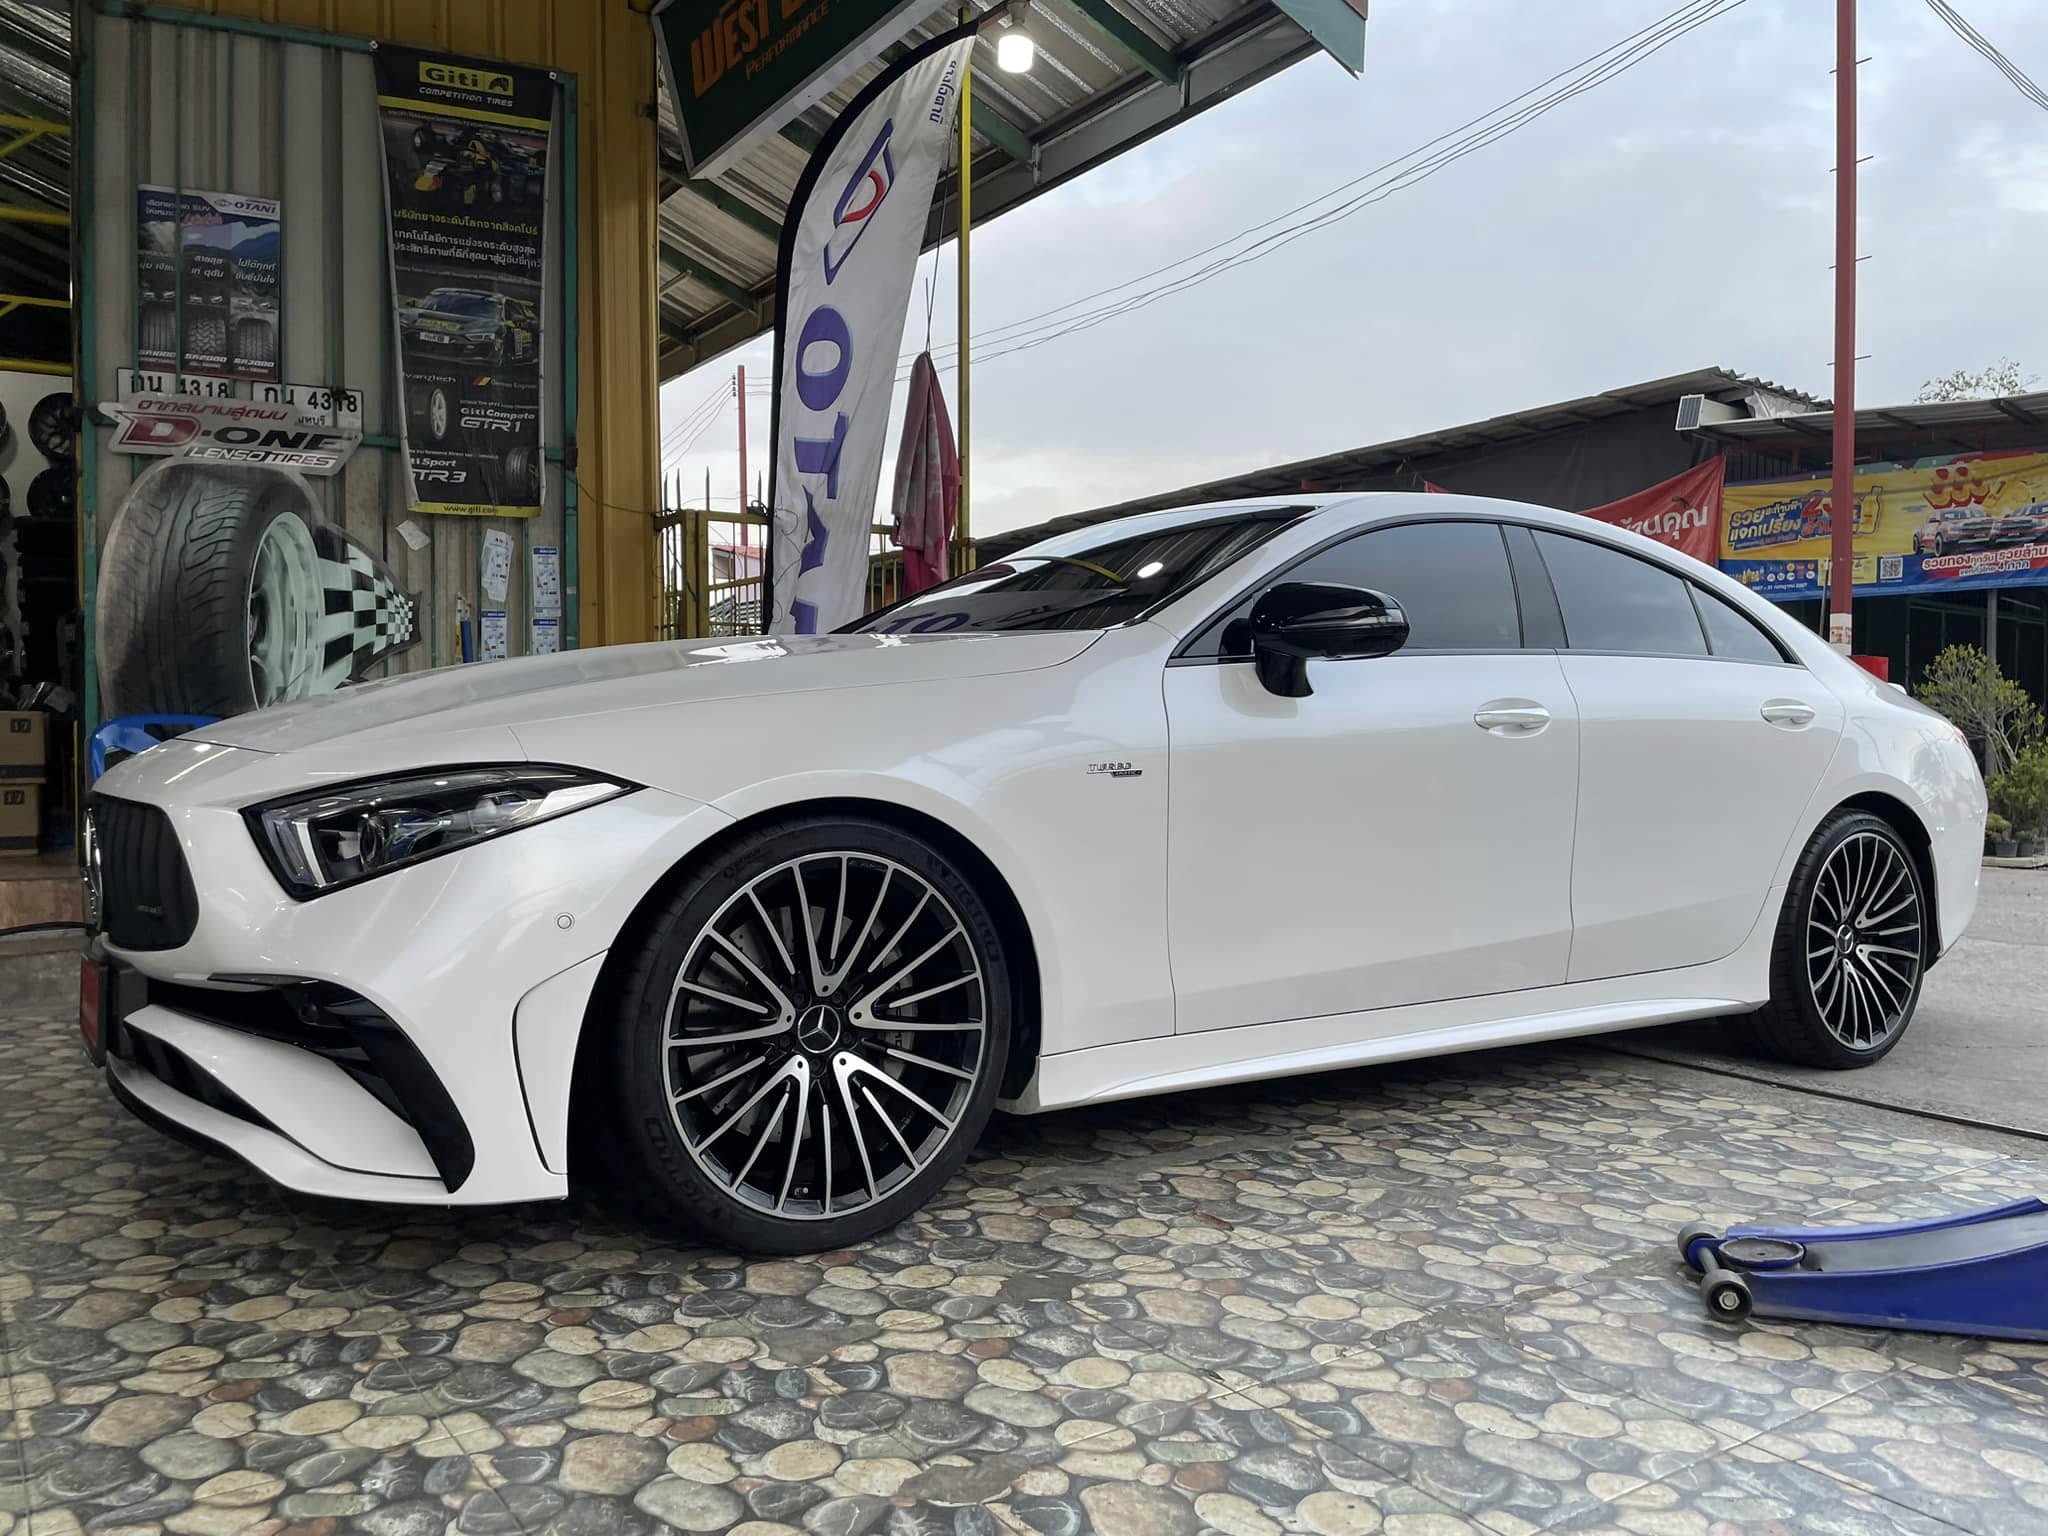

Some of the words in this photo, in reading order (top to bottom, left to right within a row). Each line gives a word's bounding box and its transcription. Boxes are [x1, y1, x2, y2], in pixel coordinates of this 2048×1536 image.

[745, 3, 829, 80] PERFORMANCE
[425, 67, 480, 88] Giti
[419, 86, 482, 103] COMPETITION
[487, 96, 513, 107] TIRES
[234, 200, 277, 214] OTANI
[189, 447, 261, 462] LENSO
